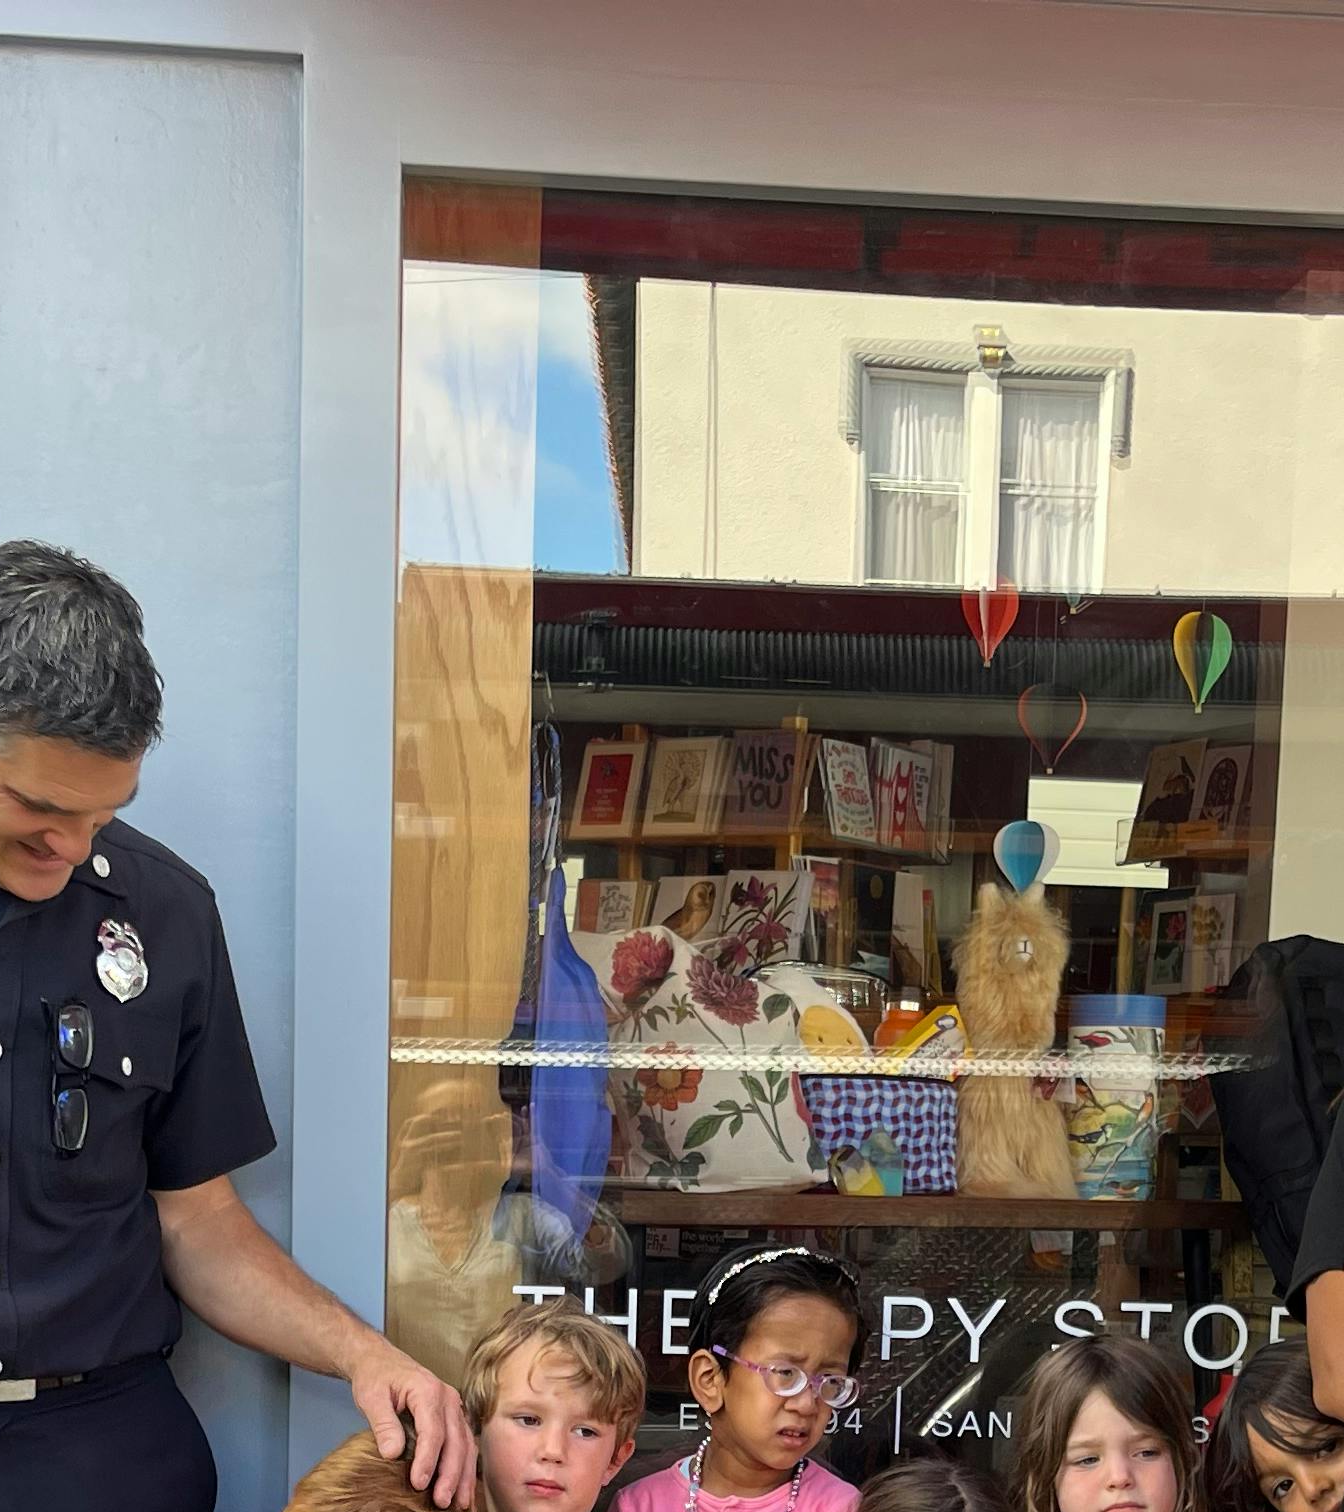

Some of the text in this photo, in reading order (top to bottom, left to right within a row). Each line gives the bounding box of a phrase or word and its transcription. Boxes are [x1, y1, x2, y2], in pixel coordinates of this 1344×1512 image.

[733, 746, 795, 784] MISS
[739, 780, 783, 813] YOU
[512, 1285, 697, 1355] THE
[881, 1296, 1006, 1363] PY
[823, 1406, 863, 1435] 94
[931, 1410, 1013, 1439] SAN
